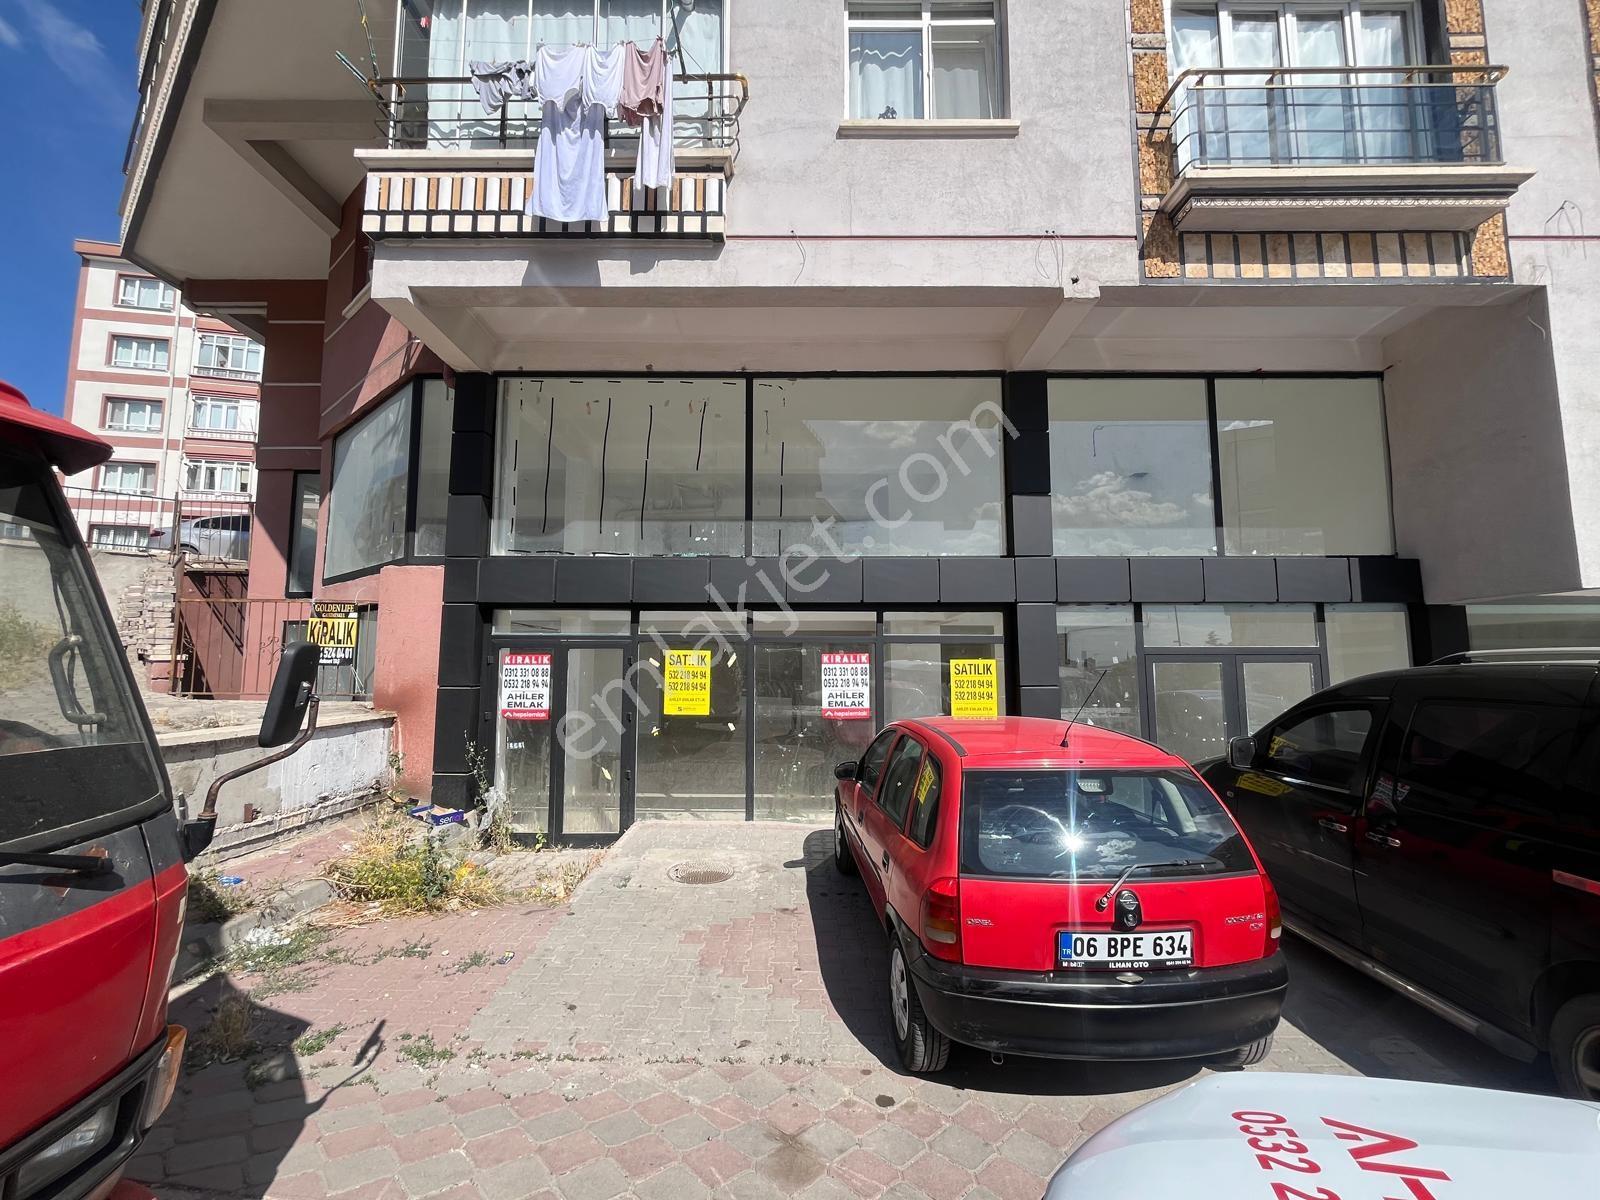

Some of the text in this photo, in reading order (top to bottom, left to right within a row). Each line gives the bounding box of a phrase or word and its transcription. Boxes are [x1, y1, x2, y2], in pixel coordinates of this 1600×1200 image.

[315, 603, 354, 612] GOLDEN LIFE
[505, 656, 549, 664] KIRALIK
[669, 654, 707, 666] SATIK
[823, 655, 867, 663] KIRALIK
[504, 668, 549, 677] 0312 331 08 88
[823, 667, 868, 676] 0312 331 08 88
[954, 663, 992, 675] SATILIK
[668, 670, 706, 680] 532 218 94 94
[503, 679, 548, 688] 0532 218 94 94
[668, 682, 706, 691] 532 218 94 94
[823, 678, 868, 687] 0532 218 94 94
[954, 679, 992, 689] 532 218 94 94
[507, 691, 544, 700] AHİLER
[827, 690, 864, 699] AHİLER
[955, 691, 993, 700] 532 218 94 94
[1073, 935, 1188, 958] 06 BPE 634
[1231, 1110, 1321, 1174] 0532
